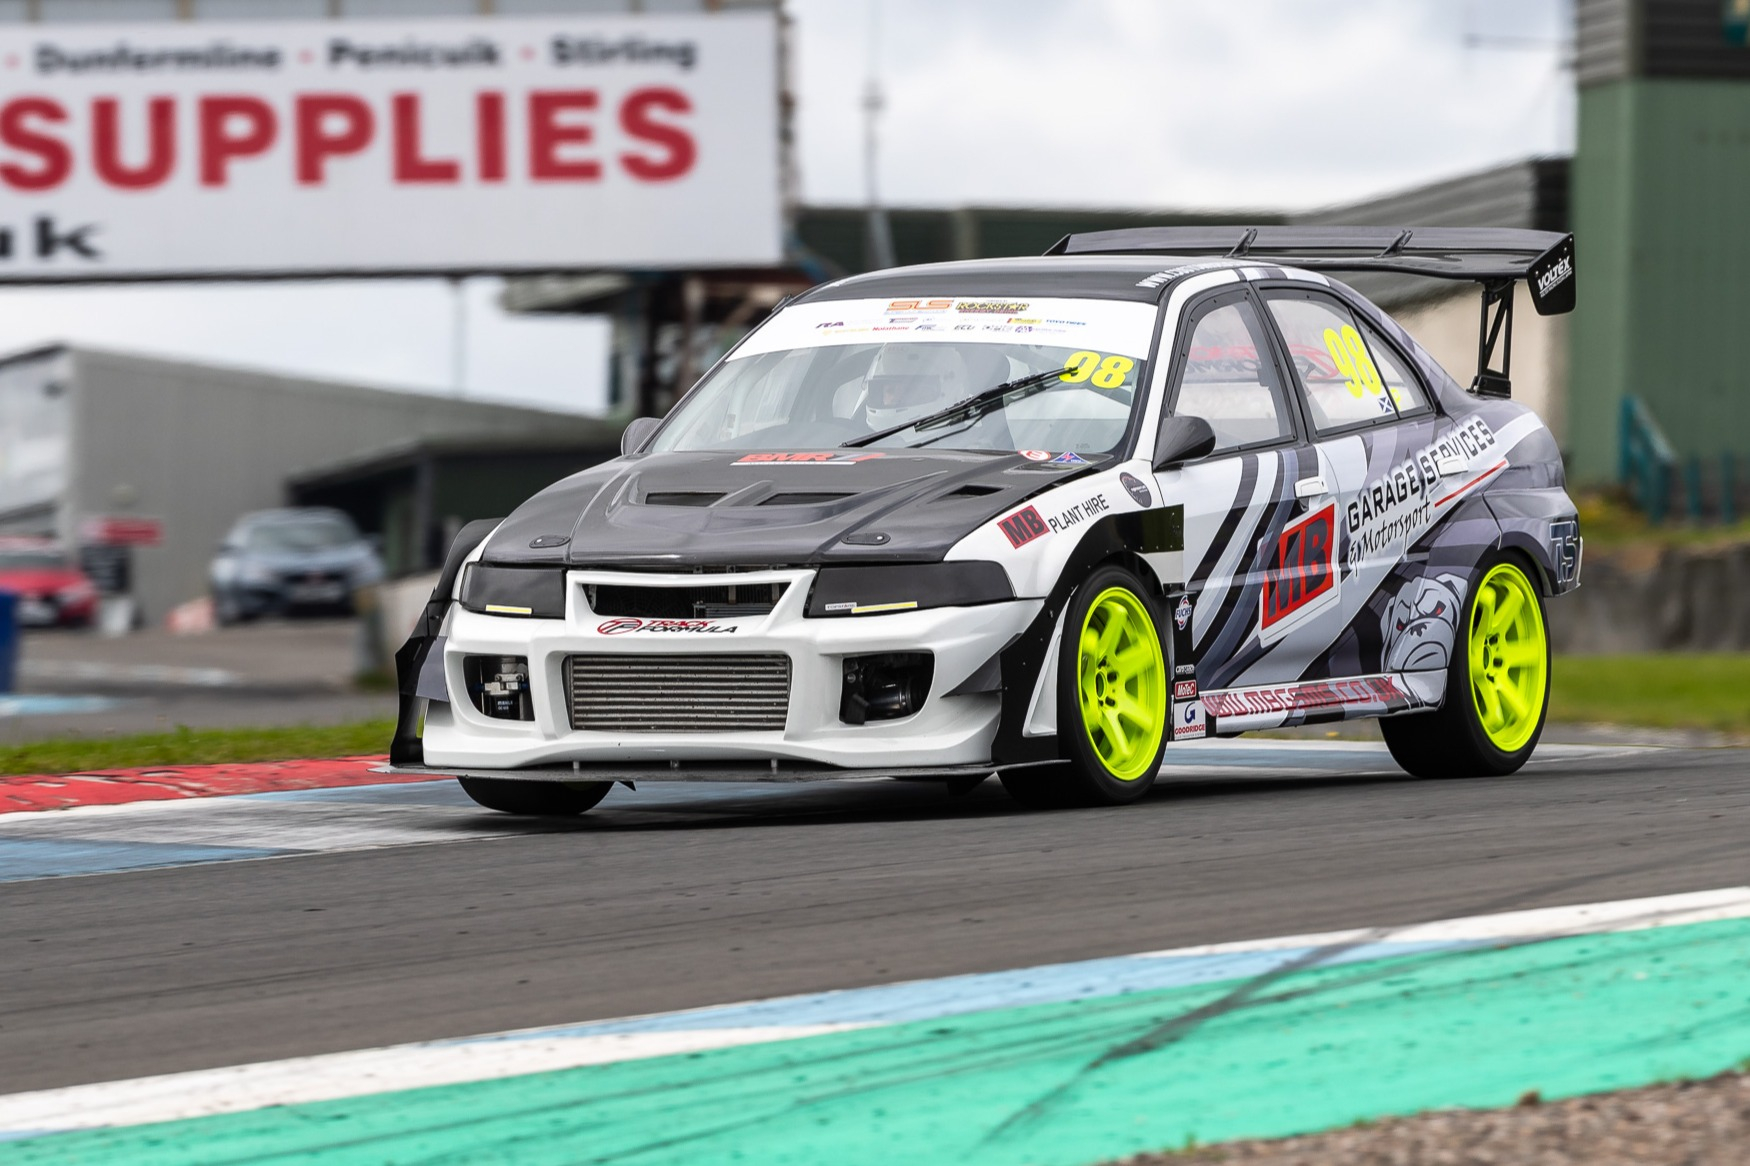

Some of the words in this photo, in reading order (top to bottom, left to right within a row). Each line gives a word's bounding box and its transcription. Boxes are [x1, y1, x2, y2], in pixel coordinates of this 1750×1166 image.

[550, 33, 698, 73] Stirling
[0, 85, 701, 193] SUPPLIES
[1538, 255, 1570, 290] VOLTEX
[886, 300, 953, 311] SLS
[1323, 325, 1381, 399] 98
[1347, 463, 1421, 534] GARAGE
[1002, 509, 1036, 545] MB
[1047, 505, 1084, 534] PLANT
[1081, 494, 1109, 518] HIRE
[1361, 495, 1432, 562] Motorsport
[1262, 517, 1329, 619] MB
[636, 625, 738, 634] FORMULA
[1175, 604, 1192, 619] FUCHS
[1176, 682, 1195, 697] MoTeC
[1174, 723, 1206, 735] GOODRIDGE
